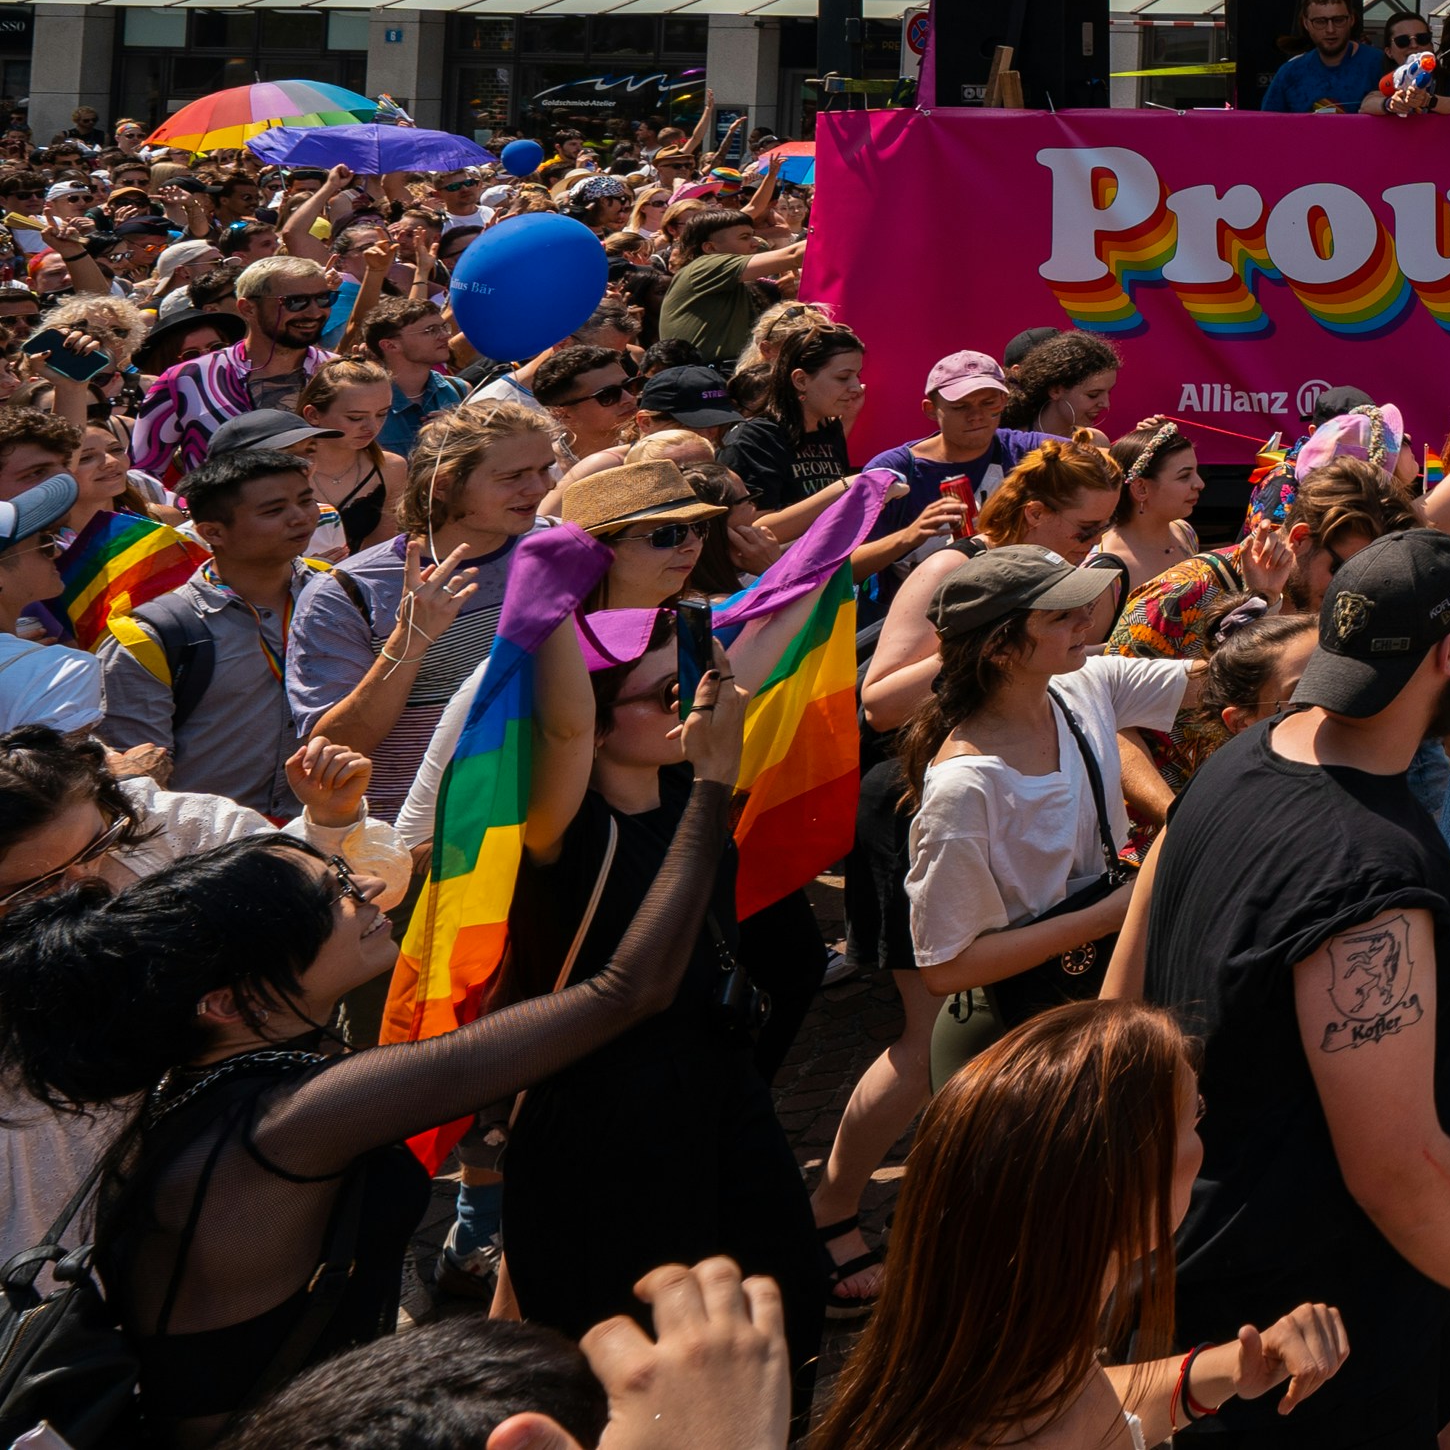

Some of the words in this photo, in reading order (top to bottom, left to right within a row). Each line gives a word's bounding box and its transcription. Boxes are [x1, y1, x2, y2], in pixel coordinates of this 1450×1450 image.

[390, 31, 397, 41] 6
[541, 99, 617, 108] Goldschmied-Atelier
[471, 281, 496, 295] Bär
[1177, 383, 1289, 414] Allianz
[791, 461, 844, 478] PEOPLE
[802, 477, 835, 495] WIT
[1352, 1015, 1402, 1044] Kofler
